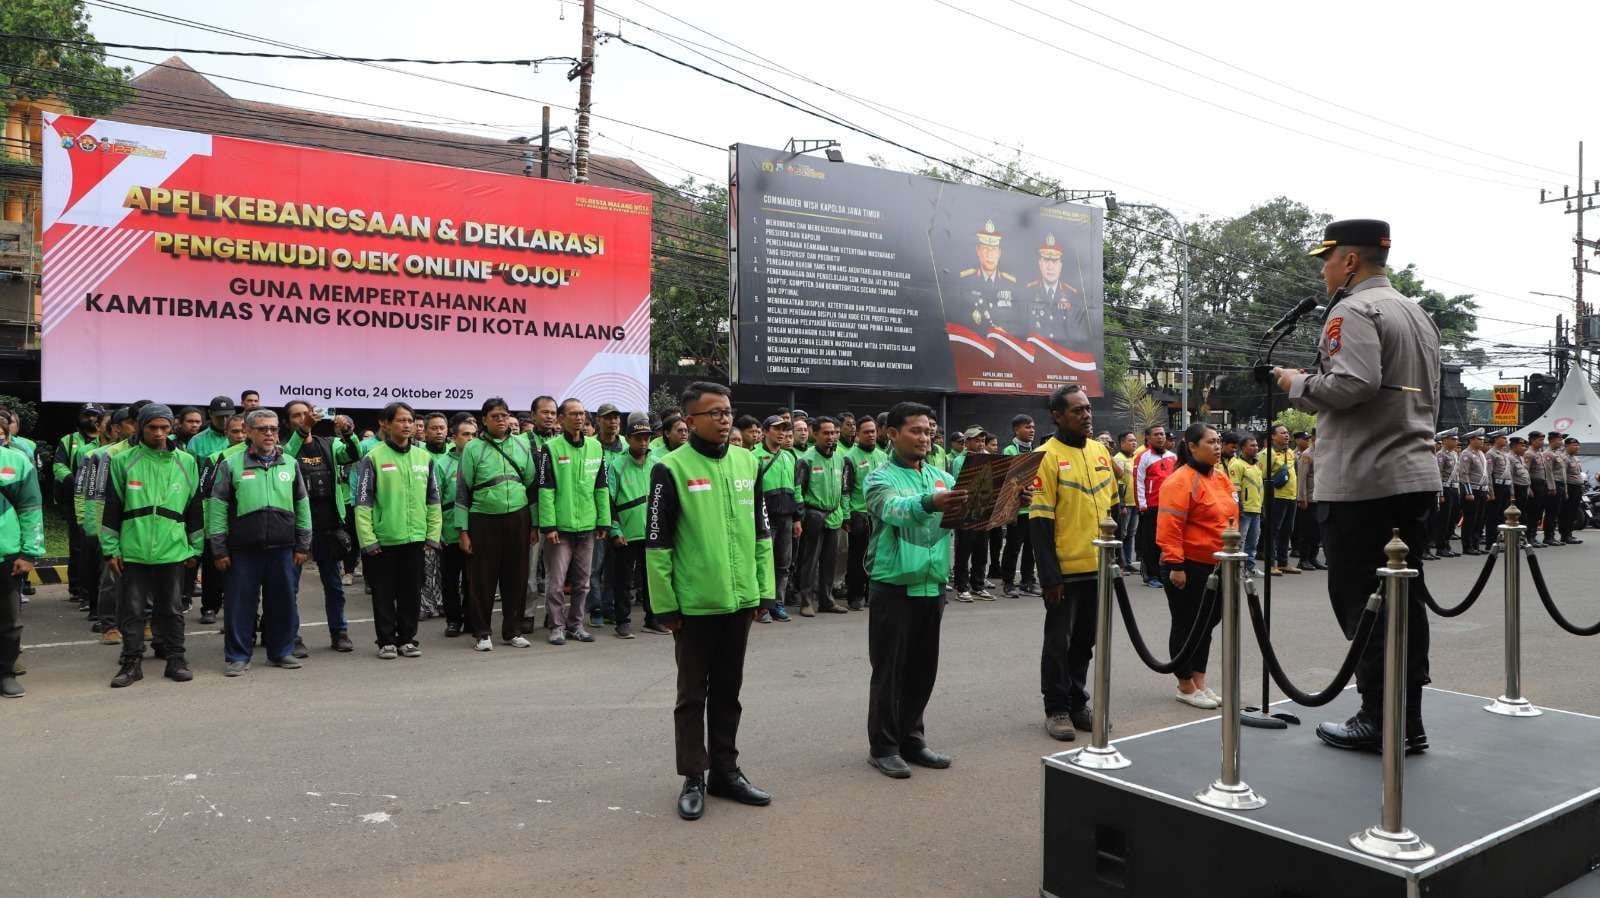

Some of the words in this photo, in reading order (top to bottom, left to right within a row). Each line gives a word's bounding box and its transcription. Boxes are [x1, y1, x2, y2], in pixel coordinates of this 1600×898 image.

[122, 186, 207, 215] APEL
[214, 194, 430, 238] KEBANGSAAN
[437, 218, 458, 240] &
[465, 222, 604, 256] DEKLARASI
[764, 195, 802, 208] COMMANDER
[804, 200, 819, 210] WISH
[820, 202, 845, 214] KAPOLDA
[863, 208, 880, 218] TIMUR
[154, 232, 325, 266] PENGEMUDI
[331, 248, 399, 272] OJEK
[406, 254, 492, 279] ONLINE
[86, 293, 252, 320] KAMTIBMAS
[259, 304, 330, 324] YANG
[337, 309, 452, 331] KONDUSIF
[457, 316, 477, 333] DI
[483, 318, 538, 336] KOTA
[543, 322, 625, 340] MALANG
[229, 278, 302, 299] GUNA
[309, 284, 526, 314] MEMPERTAHANKAN
[280, 385, 331, 399] Malang
[336, 386, 369, 398] Kota,
[373, 387, 388, 397] 24
[391, 388, 441, 398] Oktober
[445, 389, 474, 399] 2025
[650, 484, 663, 540] tokopedia
